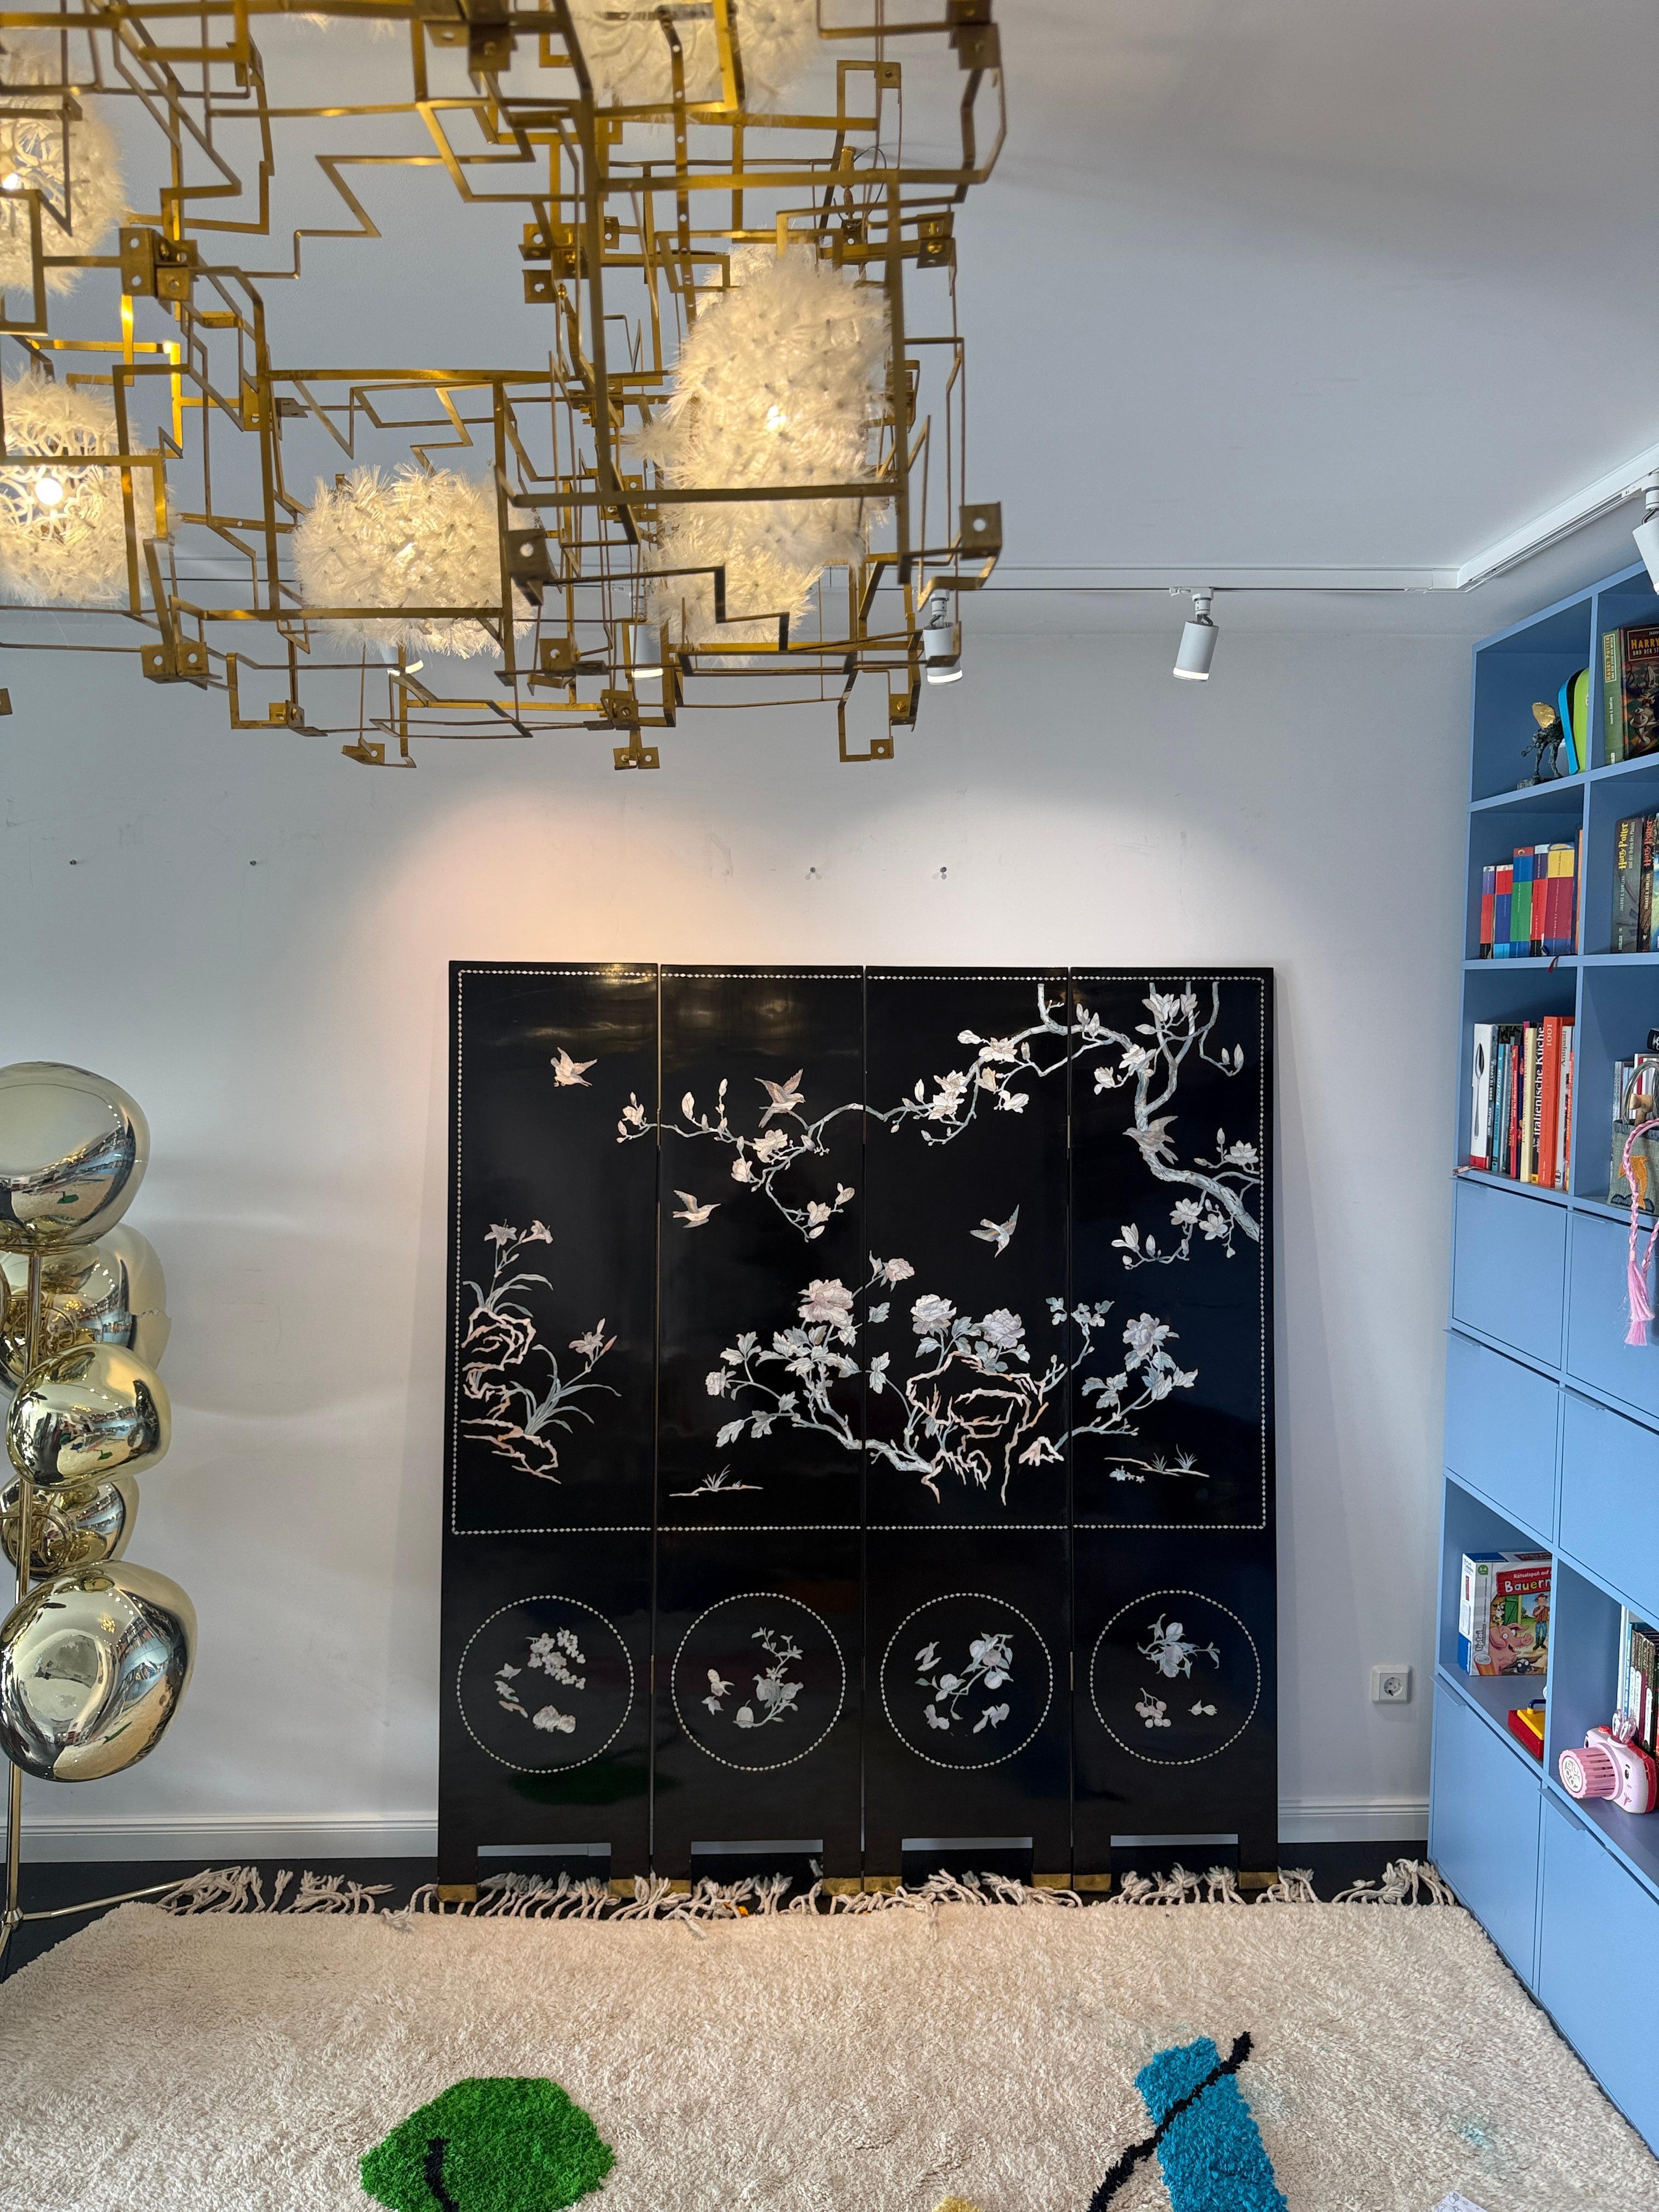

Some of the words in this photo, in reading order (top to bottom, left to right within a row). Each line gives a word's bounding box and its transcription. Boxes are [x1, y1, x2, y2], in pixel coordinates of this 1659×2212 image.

[1631, 637, 1659, 650] HARRY
[1618, 822, 1629, 848] Potter
[1644, 820, 1653, 845] Potter
[1618, 848, 1627, 870] Harry
[1535, 1026, 1544, 1066] Küche
[1533, 1069, 1543, 1135] italienische
[1504, 1578, 1551, 1593] Bauern
[1513, 1571, 1541, 1579] Rätselspaß
[1475, 1630, 1485, 1651] tiptoi
